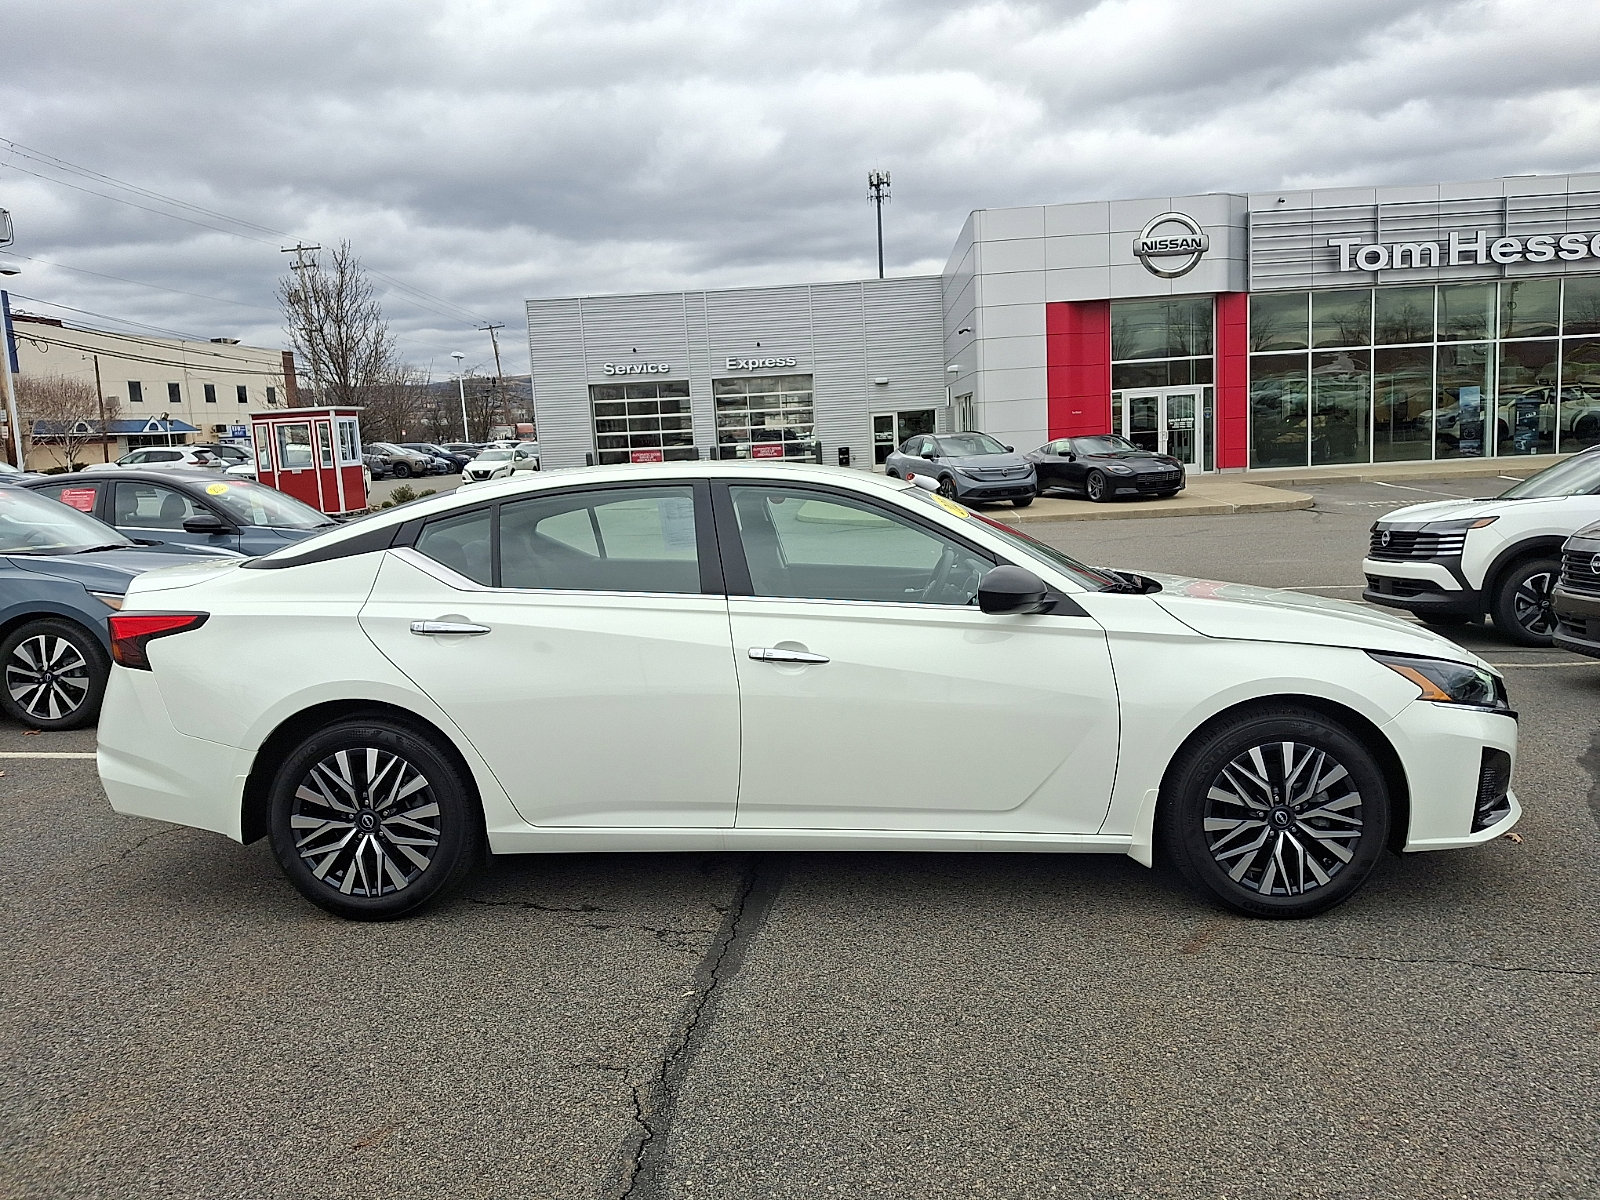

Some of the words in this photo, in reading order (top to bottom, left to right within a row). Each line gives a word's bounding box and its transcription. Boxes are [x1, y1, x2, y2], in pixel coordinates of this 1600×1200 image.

[1141, 238, 1202, 252] NISSAN
[1328, 237, 1440, 272] Tom
[603, 362, 670, 376] Service
[725, 355, 797, 371] Express
